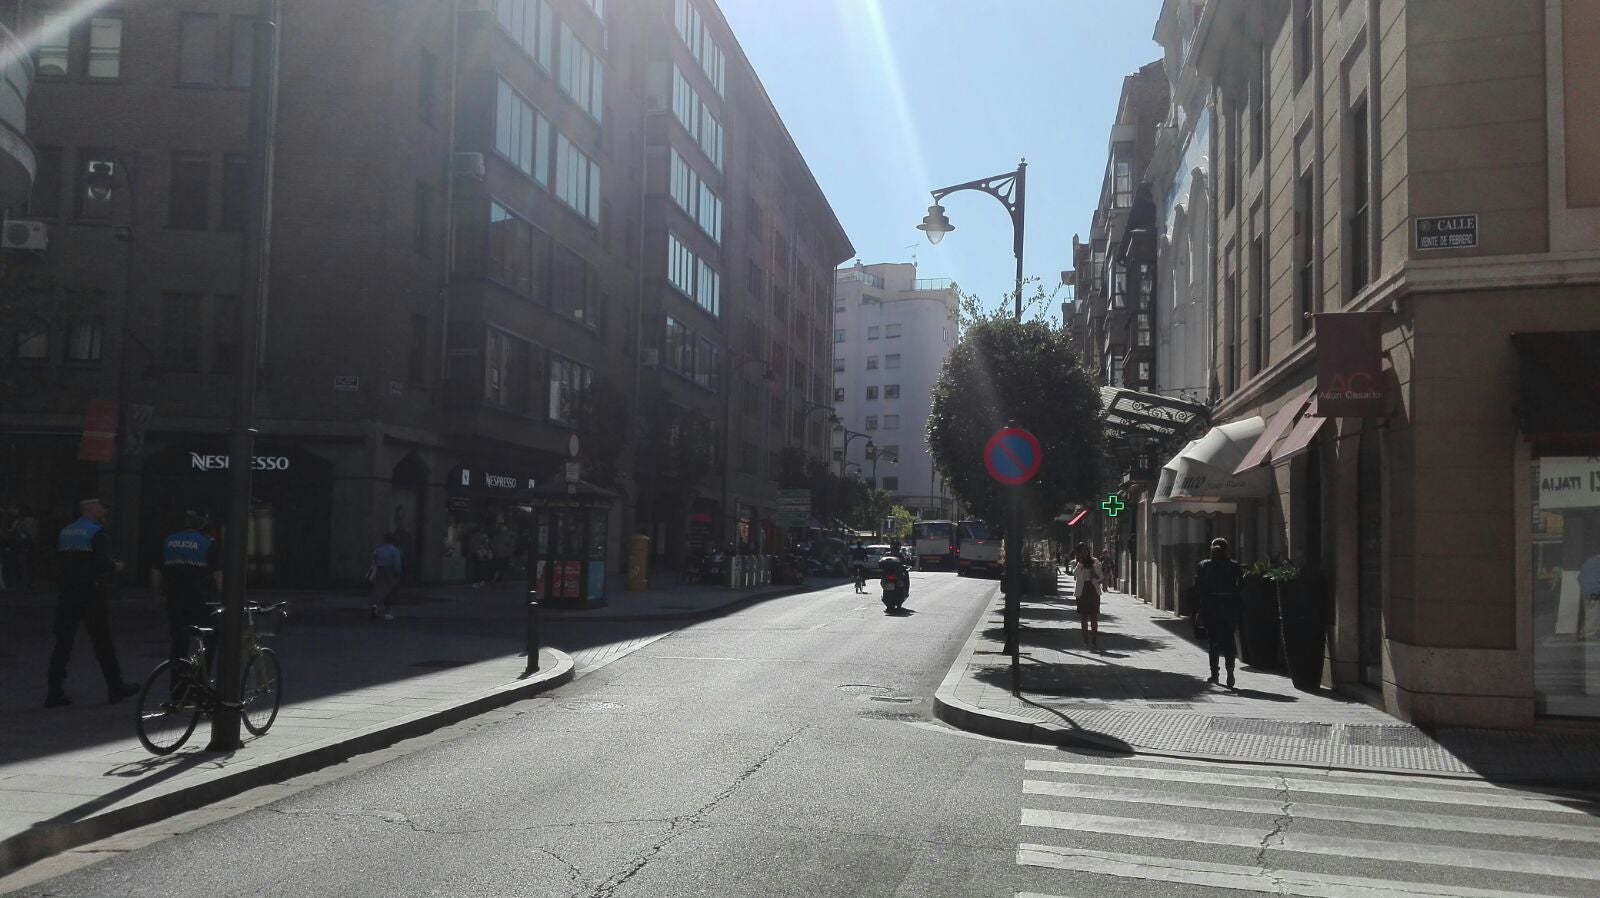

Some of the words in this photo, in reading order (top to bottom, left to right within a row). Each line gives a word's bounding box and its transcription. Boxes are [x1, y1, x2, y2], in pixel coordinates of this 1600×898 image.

[1437, 218, 1474, 231] CALLE
[1421, 236, 1438, 247] VEINTE
[1440, 235, 1447, 246] DE
[1449, 234, 1472, 245] FEBRERO
[1328, 371, 1373, 393] AC
[1345, 391, 1381, 400] Casado
[188, 451, 290, 471] NESESSO
[485, 472, 517, 488] NESPRESSO
